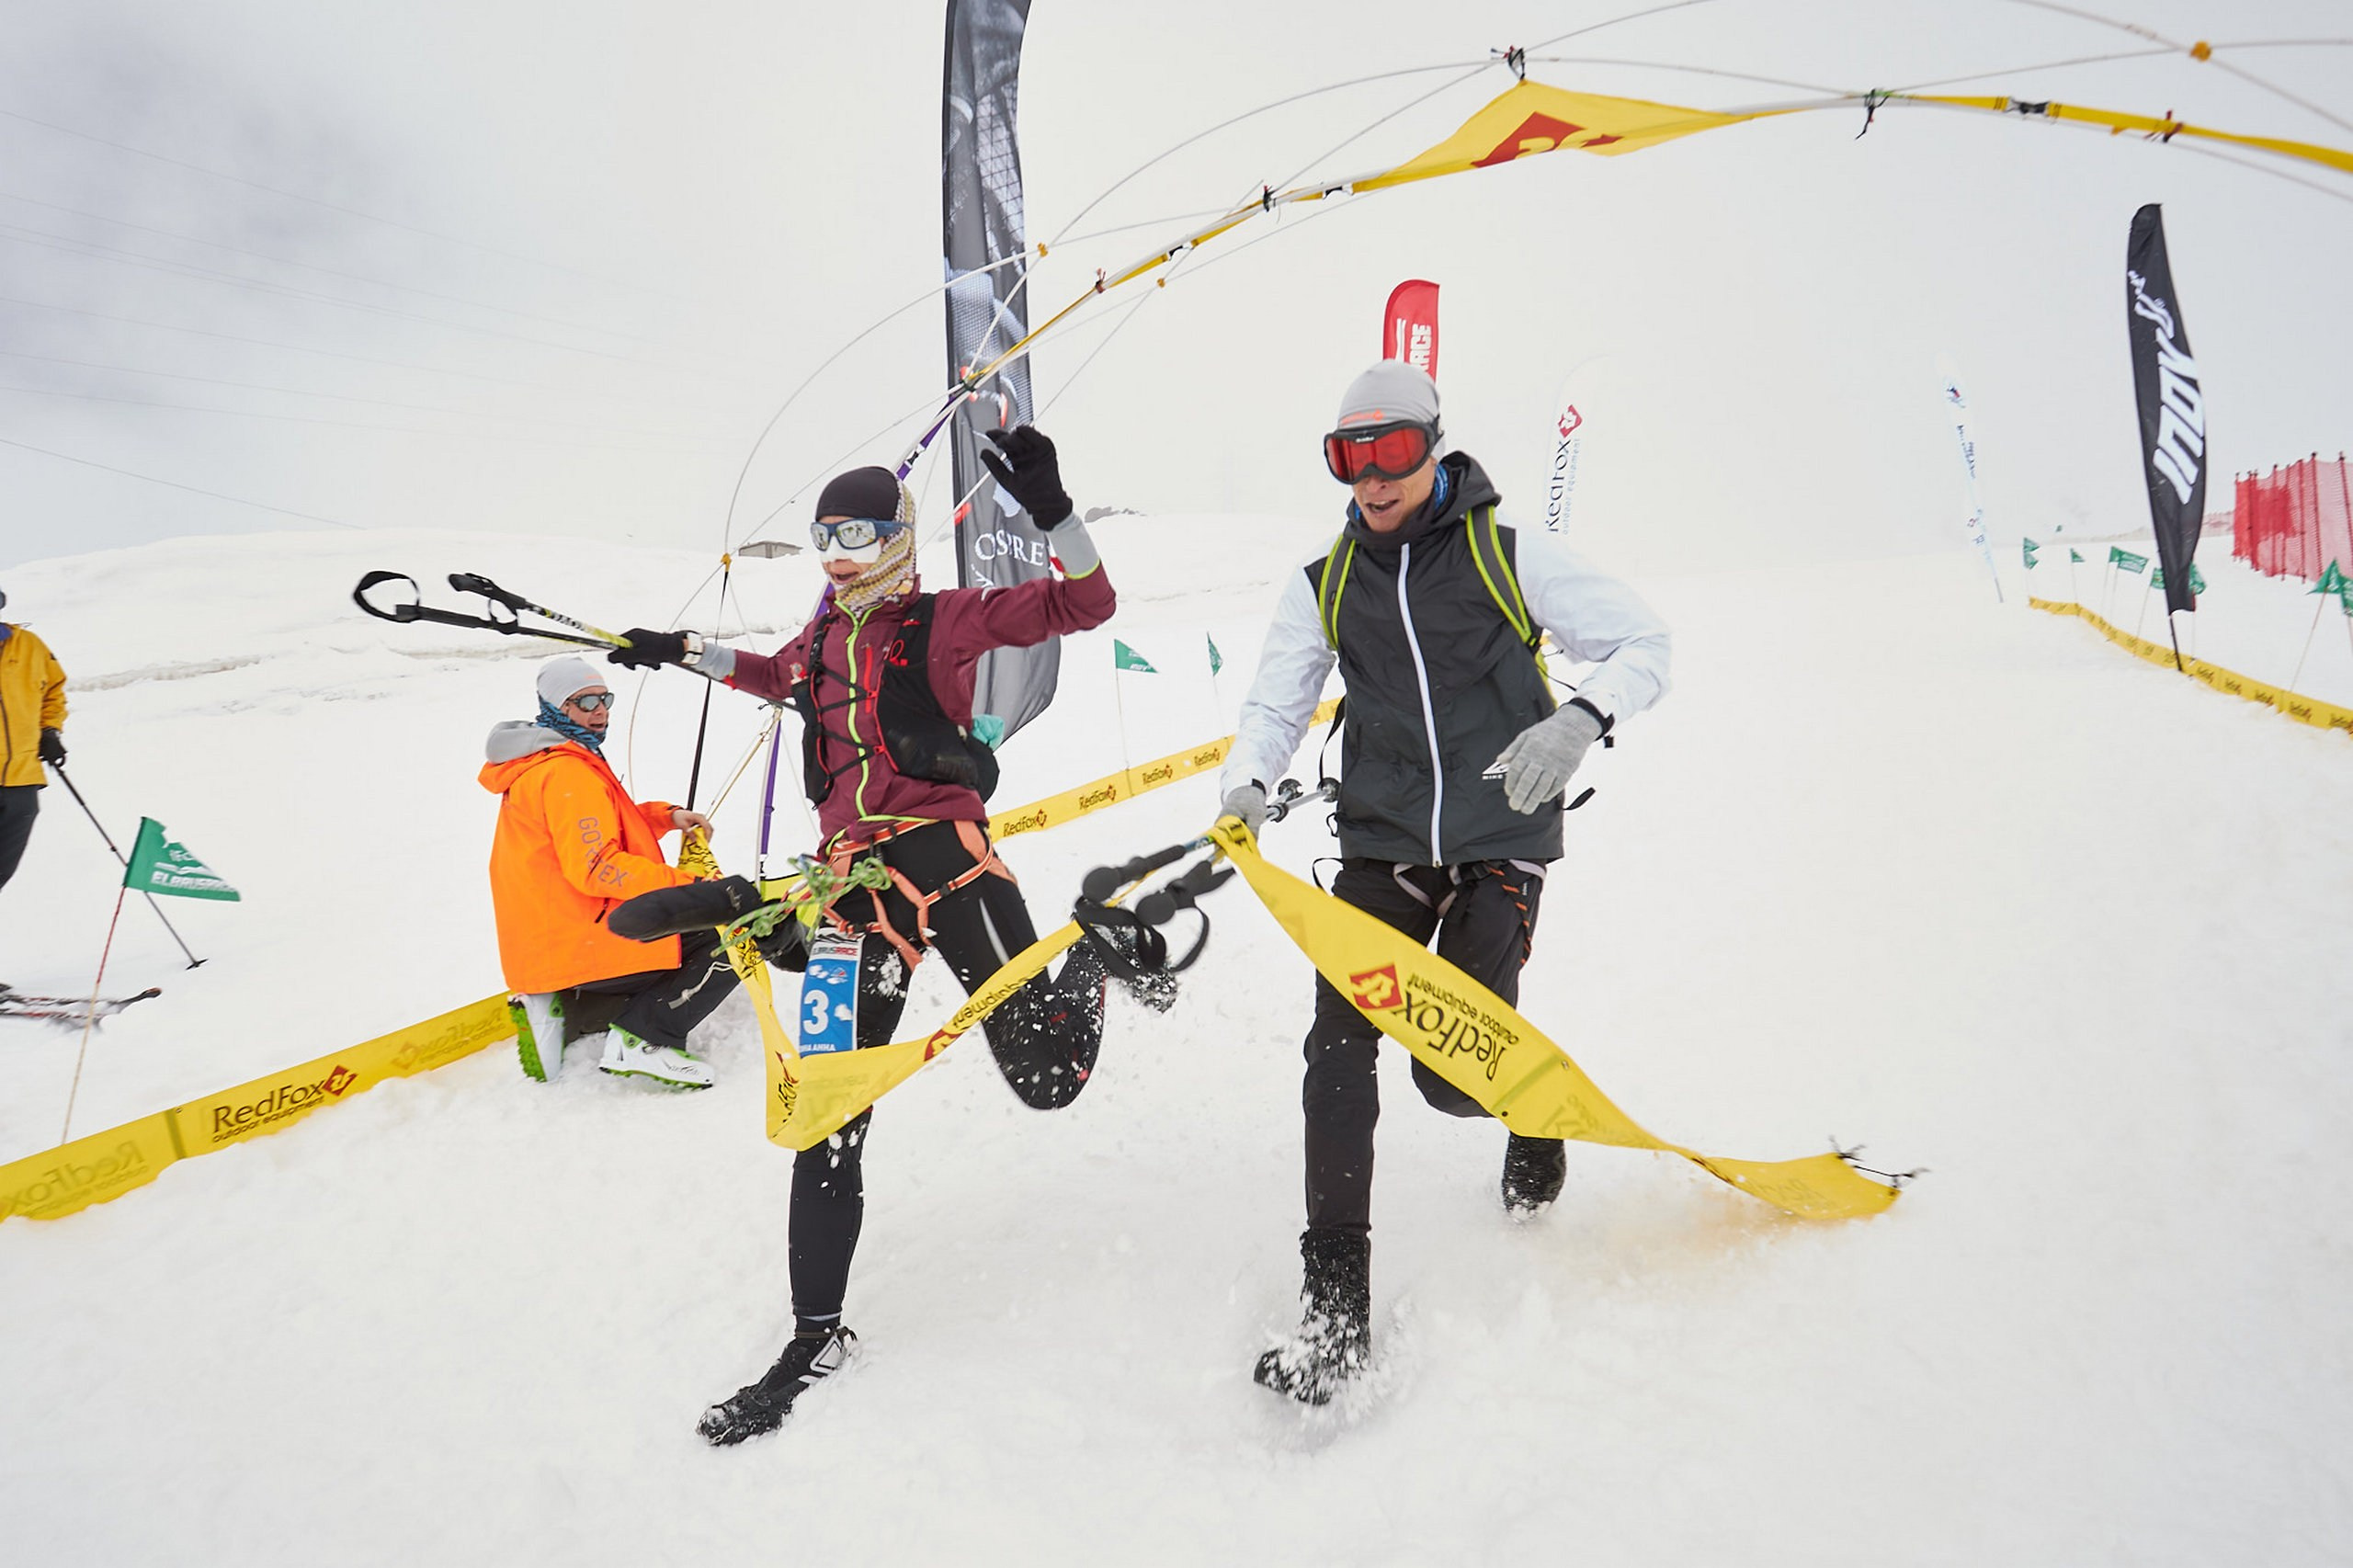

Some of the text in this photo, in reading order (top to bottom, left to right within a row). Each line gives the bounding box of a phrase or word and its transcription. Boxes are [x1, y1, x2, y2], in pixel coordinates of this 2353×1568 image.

[802, 989, 830, 1035] 3
[1391, 990, 1507, 1082] RedFox
[1407, 972, 1519, 1045] outdoor equipment
[211, 1079, 325, 1134] RedFox
